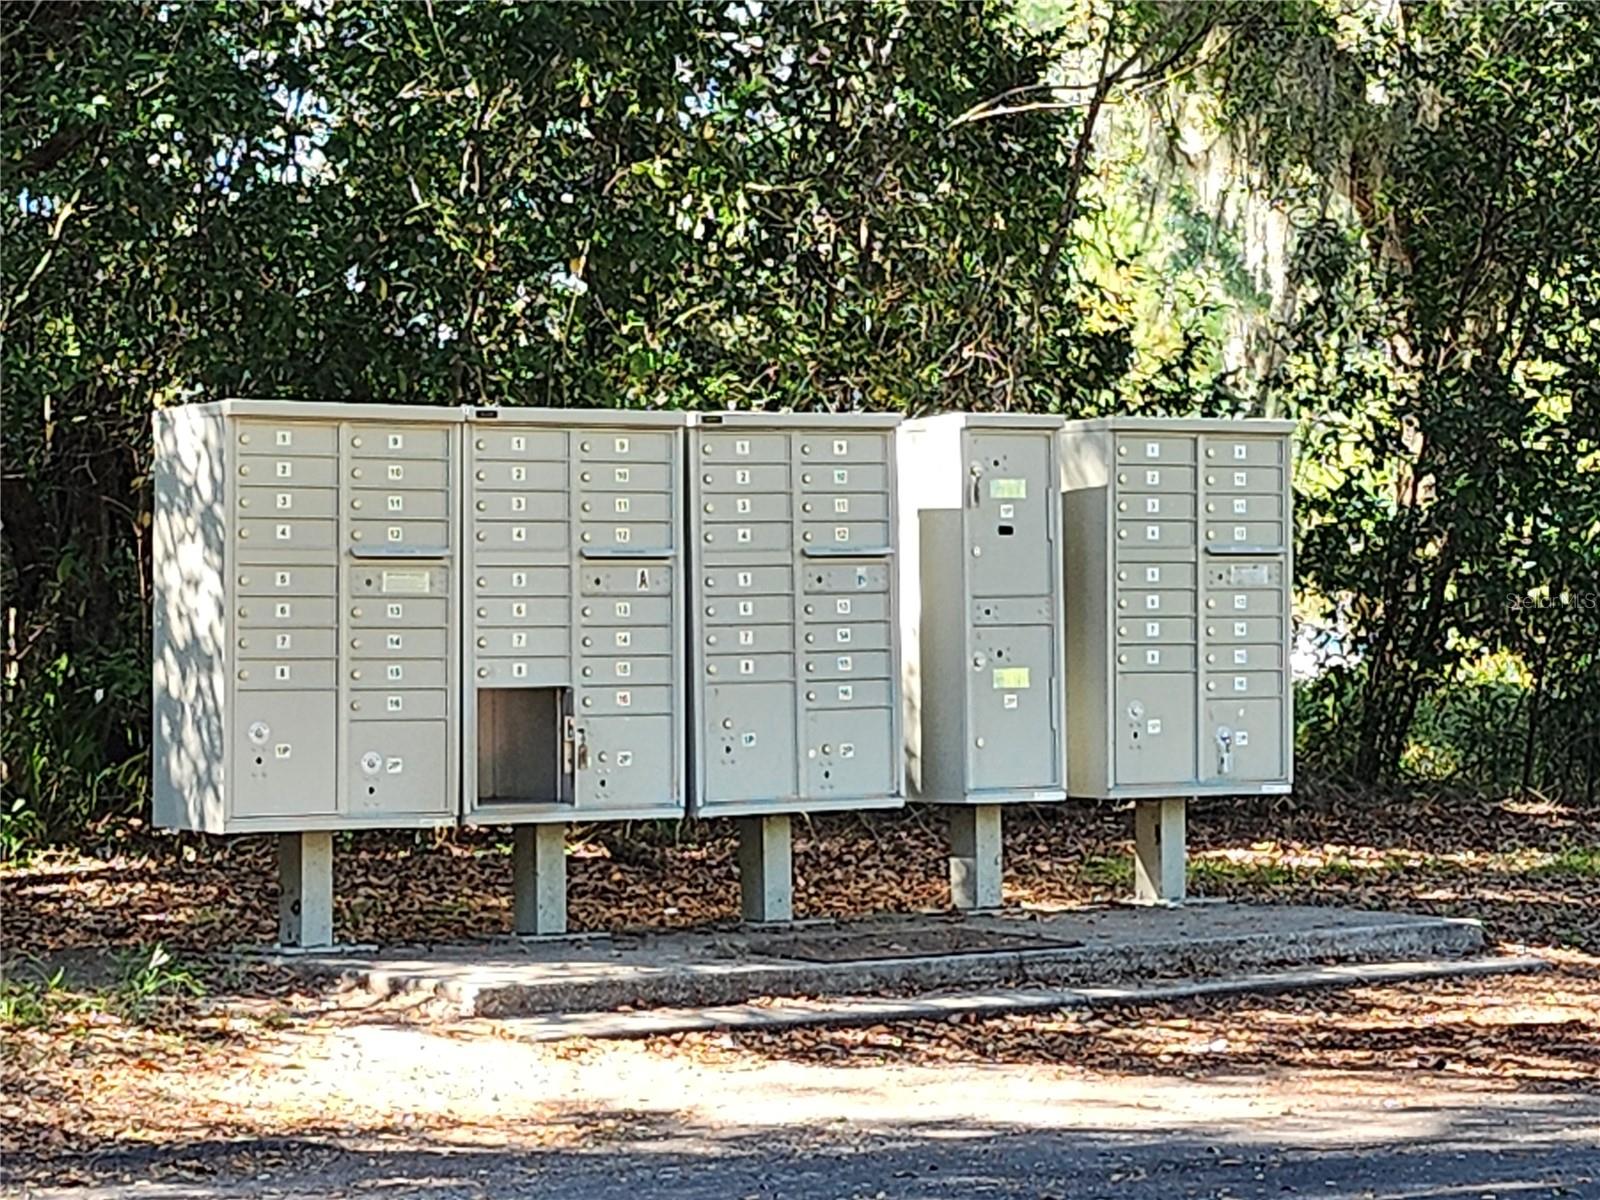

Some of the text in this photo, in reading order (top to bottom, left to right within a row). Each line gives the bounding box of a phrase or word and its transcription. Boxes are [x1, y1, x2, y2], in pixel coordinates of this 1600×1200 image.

[391, 468, 401, 477] 10
[390, 498, 400, 508] 11
[618, 501, 627, 510] 11
[391, 530, 400, 539] 12
[618, 531, 627, 540] 12
[639, 569, 649, 589] A
[390, 606, 400, 616] 13
[619, 635, 627, 644] 14
